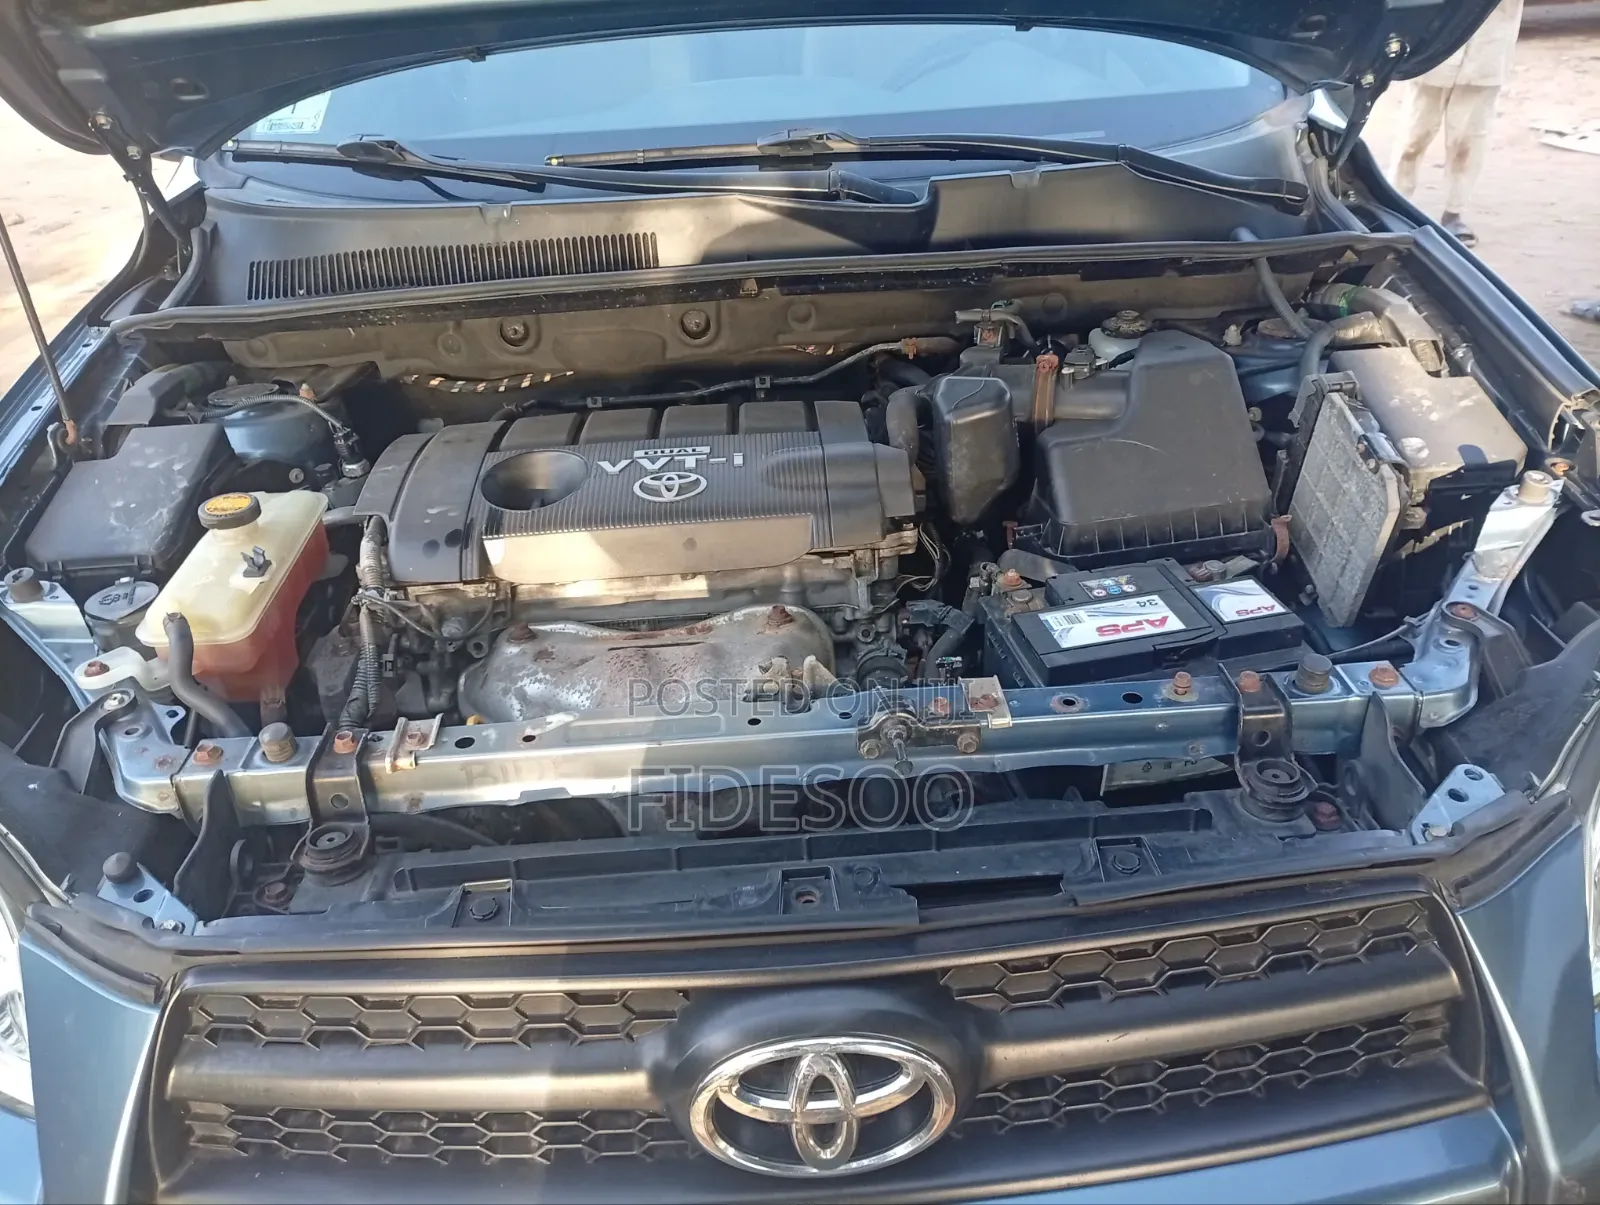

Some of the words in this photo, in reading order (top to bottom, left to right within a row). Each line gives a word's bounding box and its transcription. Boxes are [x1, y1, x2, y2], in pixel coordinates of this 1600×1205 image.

[642, 446, 706, 457] DUAL
[1235, 604, 1276, 617] APS
[1096, 615, 1170, 637] APS
